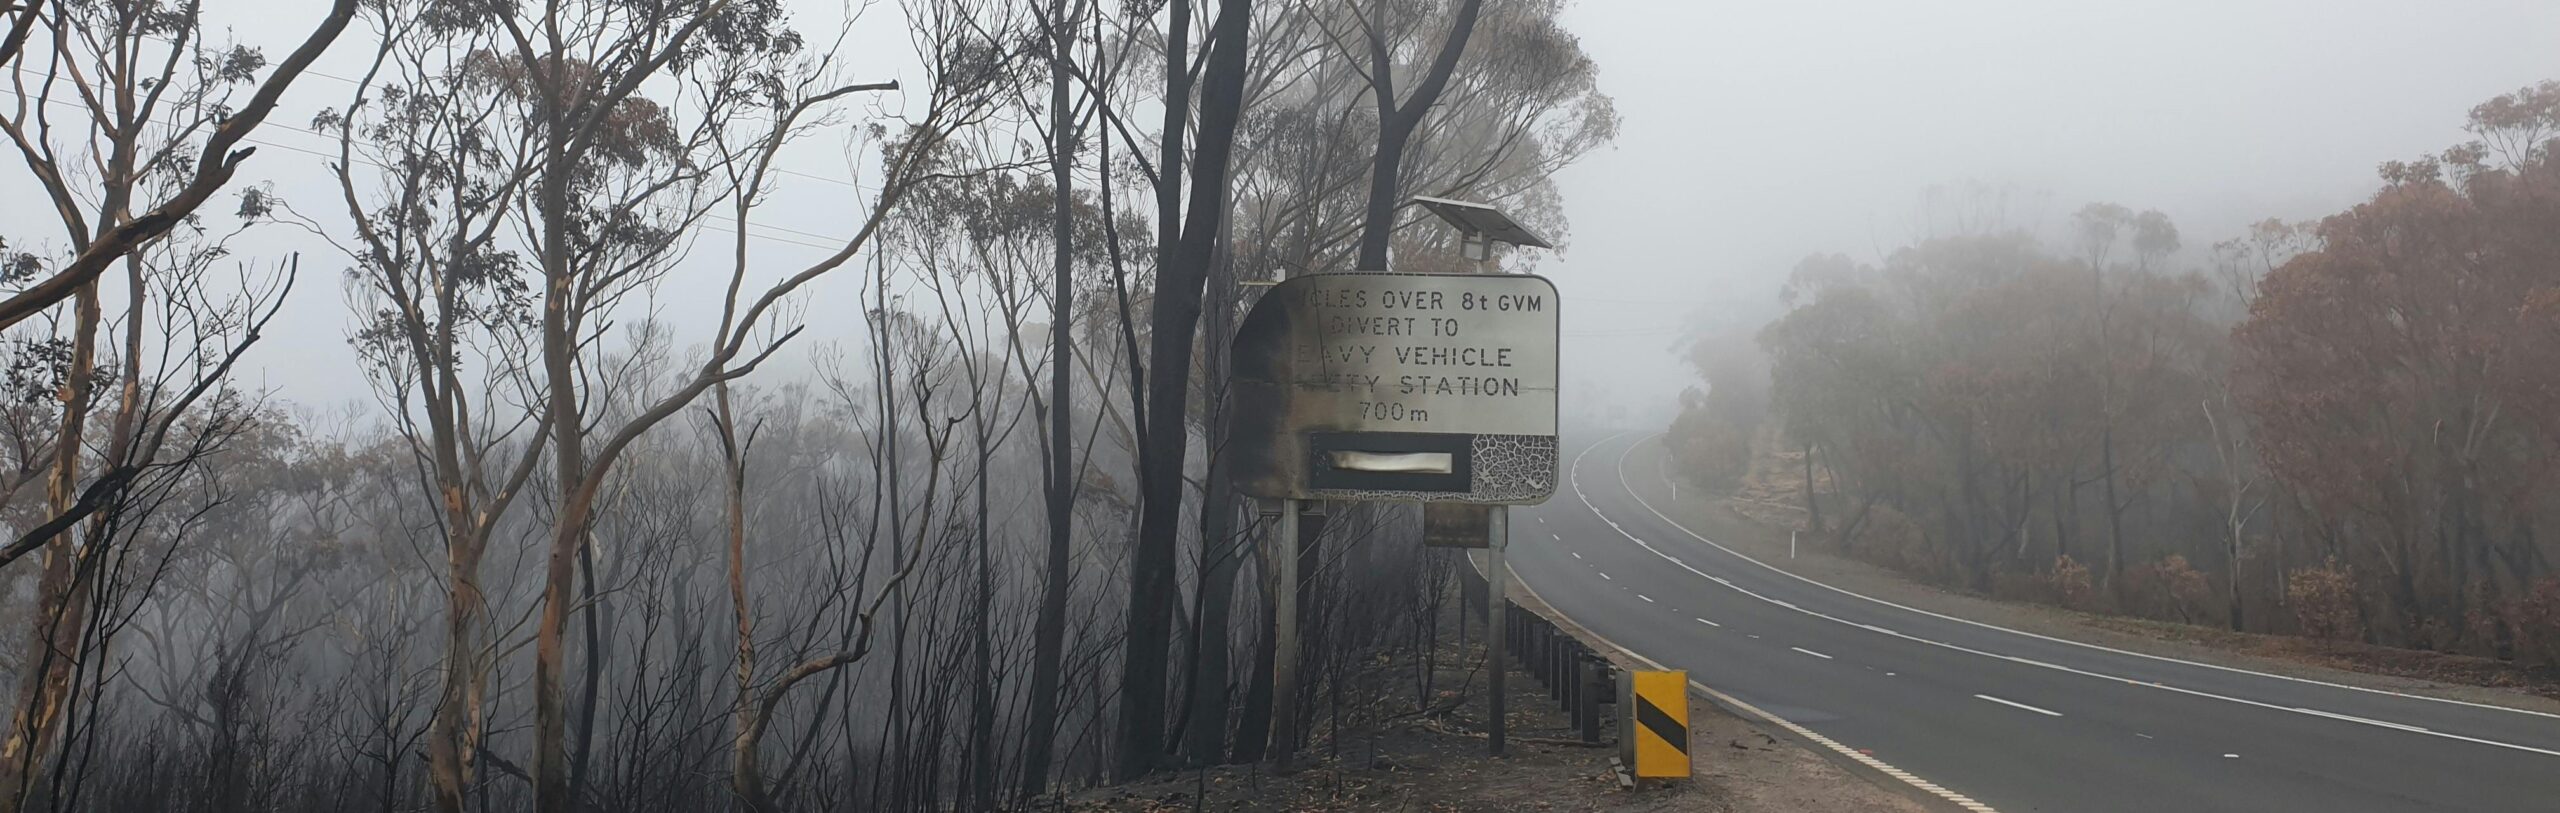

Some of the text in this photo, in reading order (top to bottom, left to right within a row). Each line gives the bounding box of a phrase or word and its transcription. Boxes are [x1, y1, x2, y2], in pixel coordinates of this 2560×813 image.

[1302, 289, 1367, 308] ICLES
[1382, 290, 1443, 309] OVER
[1498, 295, 1541, 312] GVM
[1331, 316, 1458, 337] DIVERT TO
[1298, 344, 1512, 367] EAVY VEHICLE
[1400, 375, 1518, 397] STATION
